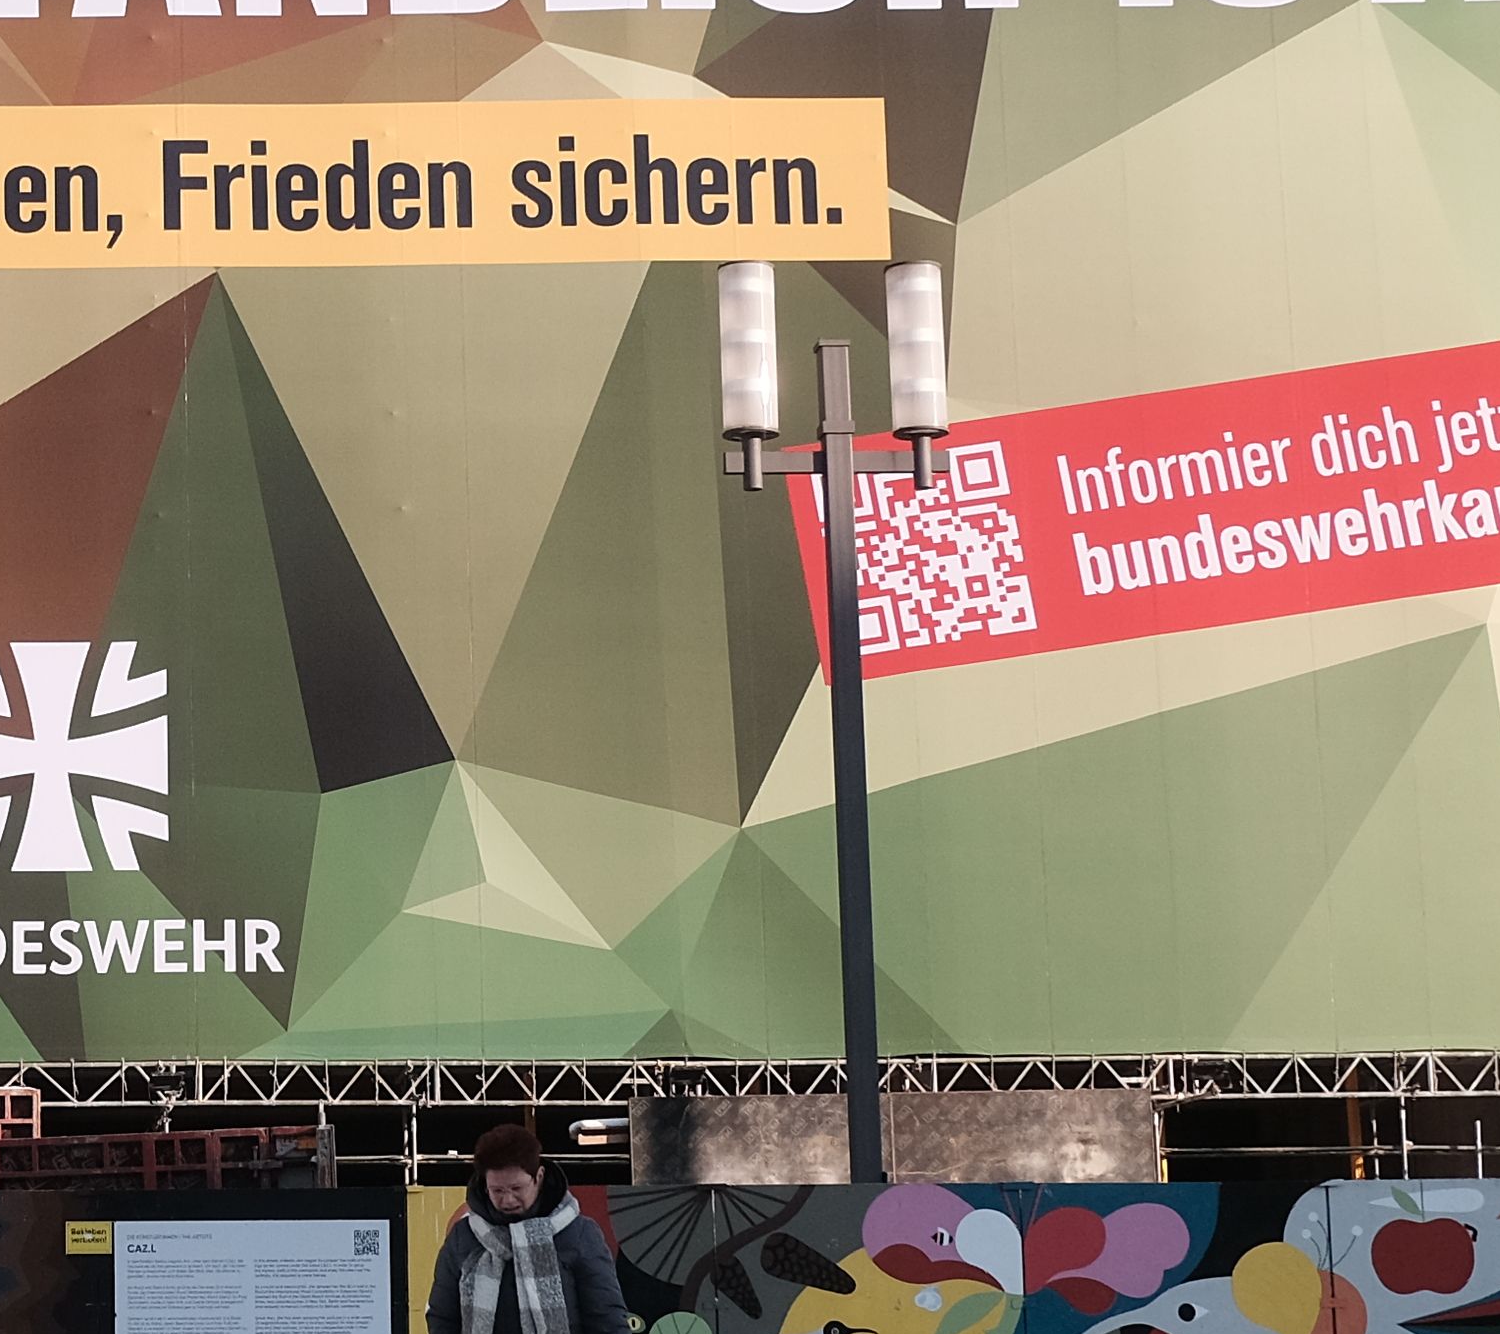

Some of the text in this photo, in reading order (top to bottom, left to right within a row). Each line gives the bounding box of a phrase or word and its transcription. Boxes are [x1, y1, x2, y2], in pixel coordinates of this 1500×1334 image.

[162, 139, 473, 232] Frieden
[511, 134, 842, 228] sichern.
[1057, 431, 1292, 515] Informier
[1310, 405, 1421, 477] dich
[126, 1243, 157, 1254] CAZ.L
